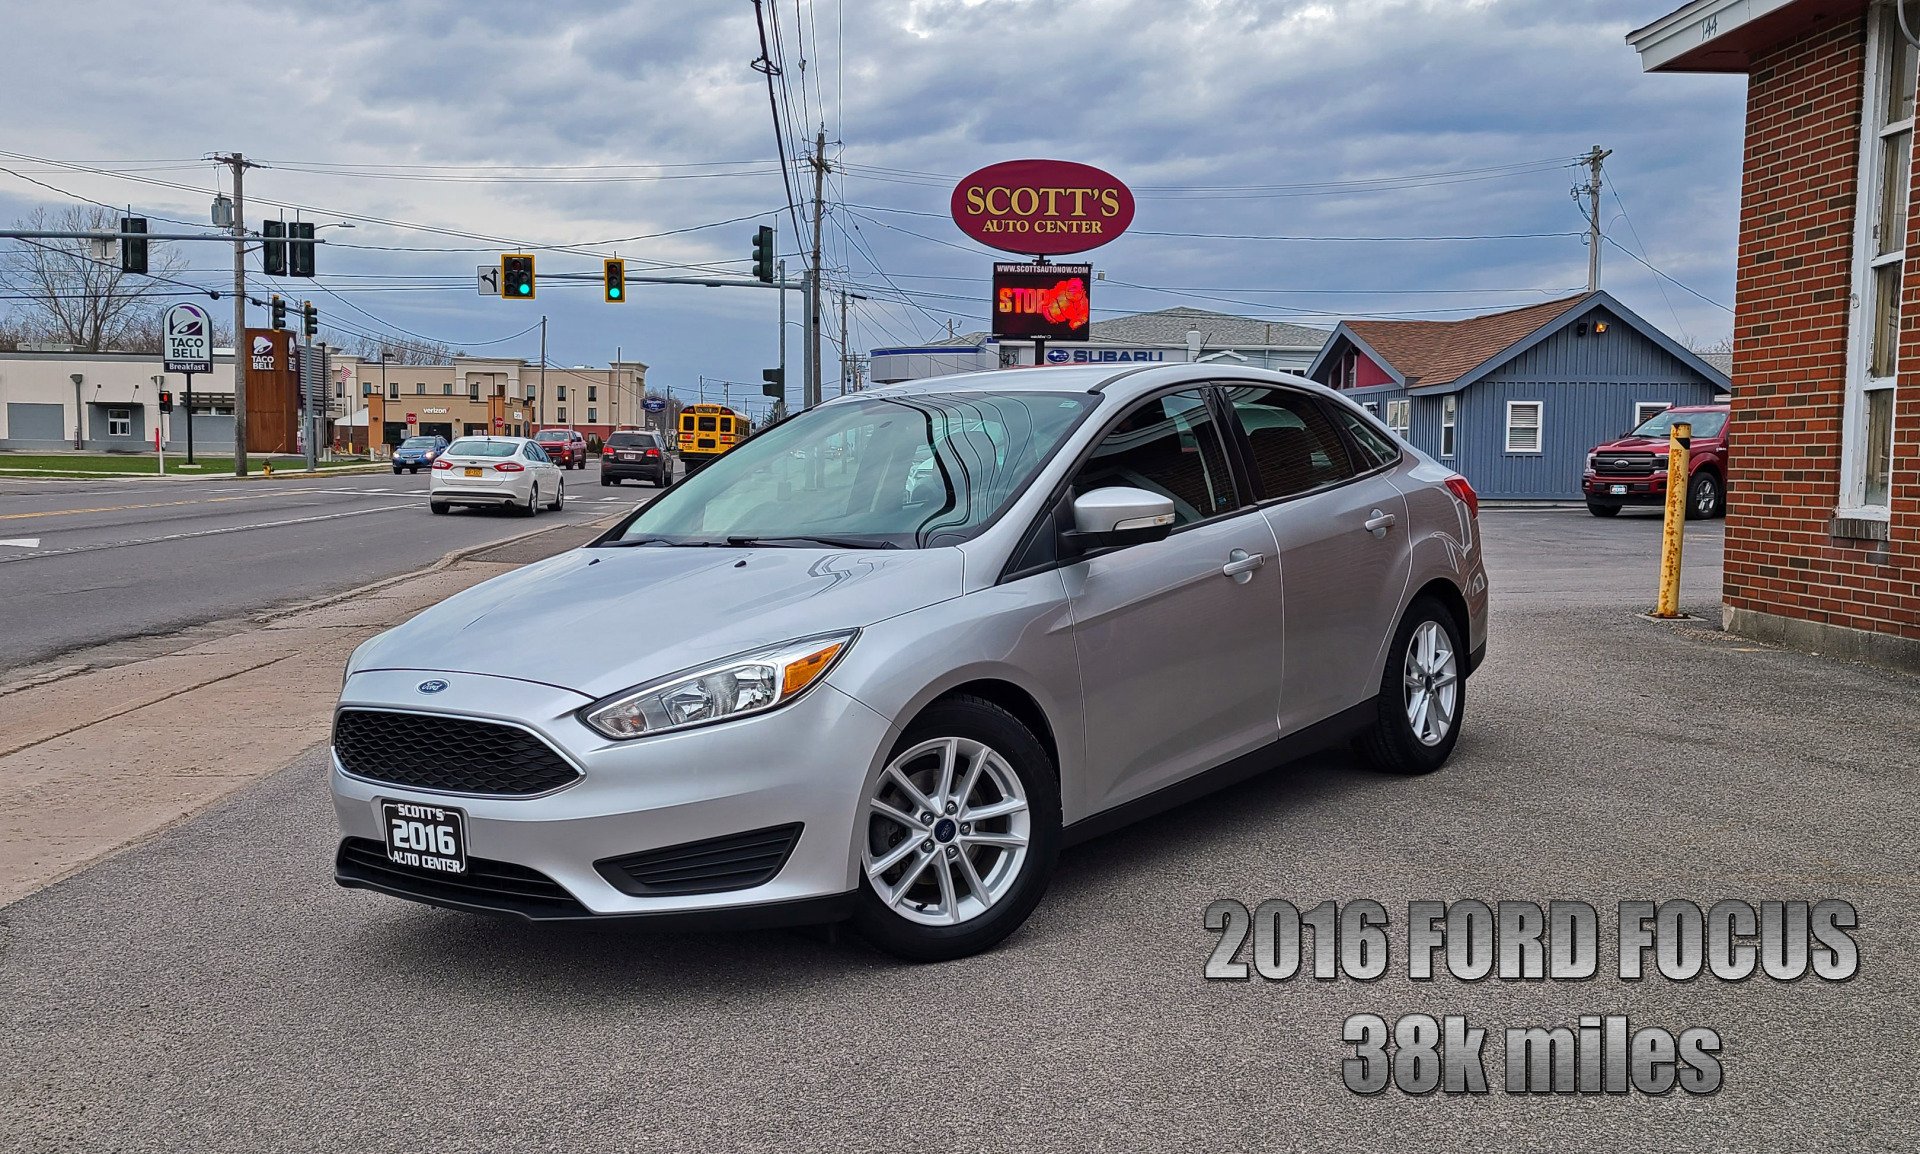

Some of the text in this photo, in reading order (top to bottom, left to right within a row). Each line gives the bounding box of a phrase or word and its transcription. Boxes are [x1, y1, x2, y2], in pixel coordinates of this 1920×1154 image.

[1701, 14, 1718, 41] 144
[966, 186, 1120, 217] SCOTT'S
[982, 219, 1103, 234] AUTO CENTER
[997, 264, 1089, 274] WWW.SCOTTSAUTONOW.COM
[999, 288, 1049, 314] STOP
[170, 338, 204, 348] TACO
[172, 349, 204, 358] BELL
[251, 355, 274, 363] TACO
[1073, 350, 1163, 362] SUBARU
[169, 362, 205, 370] Breakfast
[398, 803, 445, 821] SCOTT'S
[392, 818, 456, 855] 2016
[392, 850, 461, 873] AUTO CENTER
